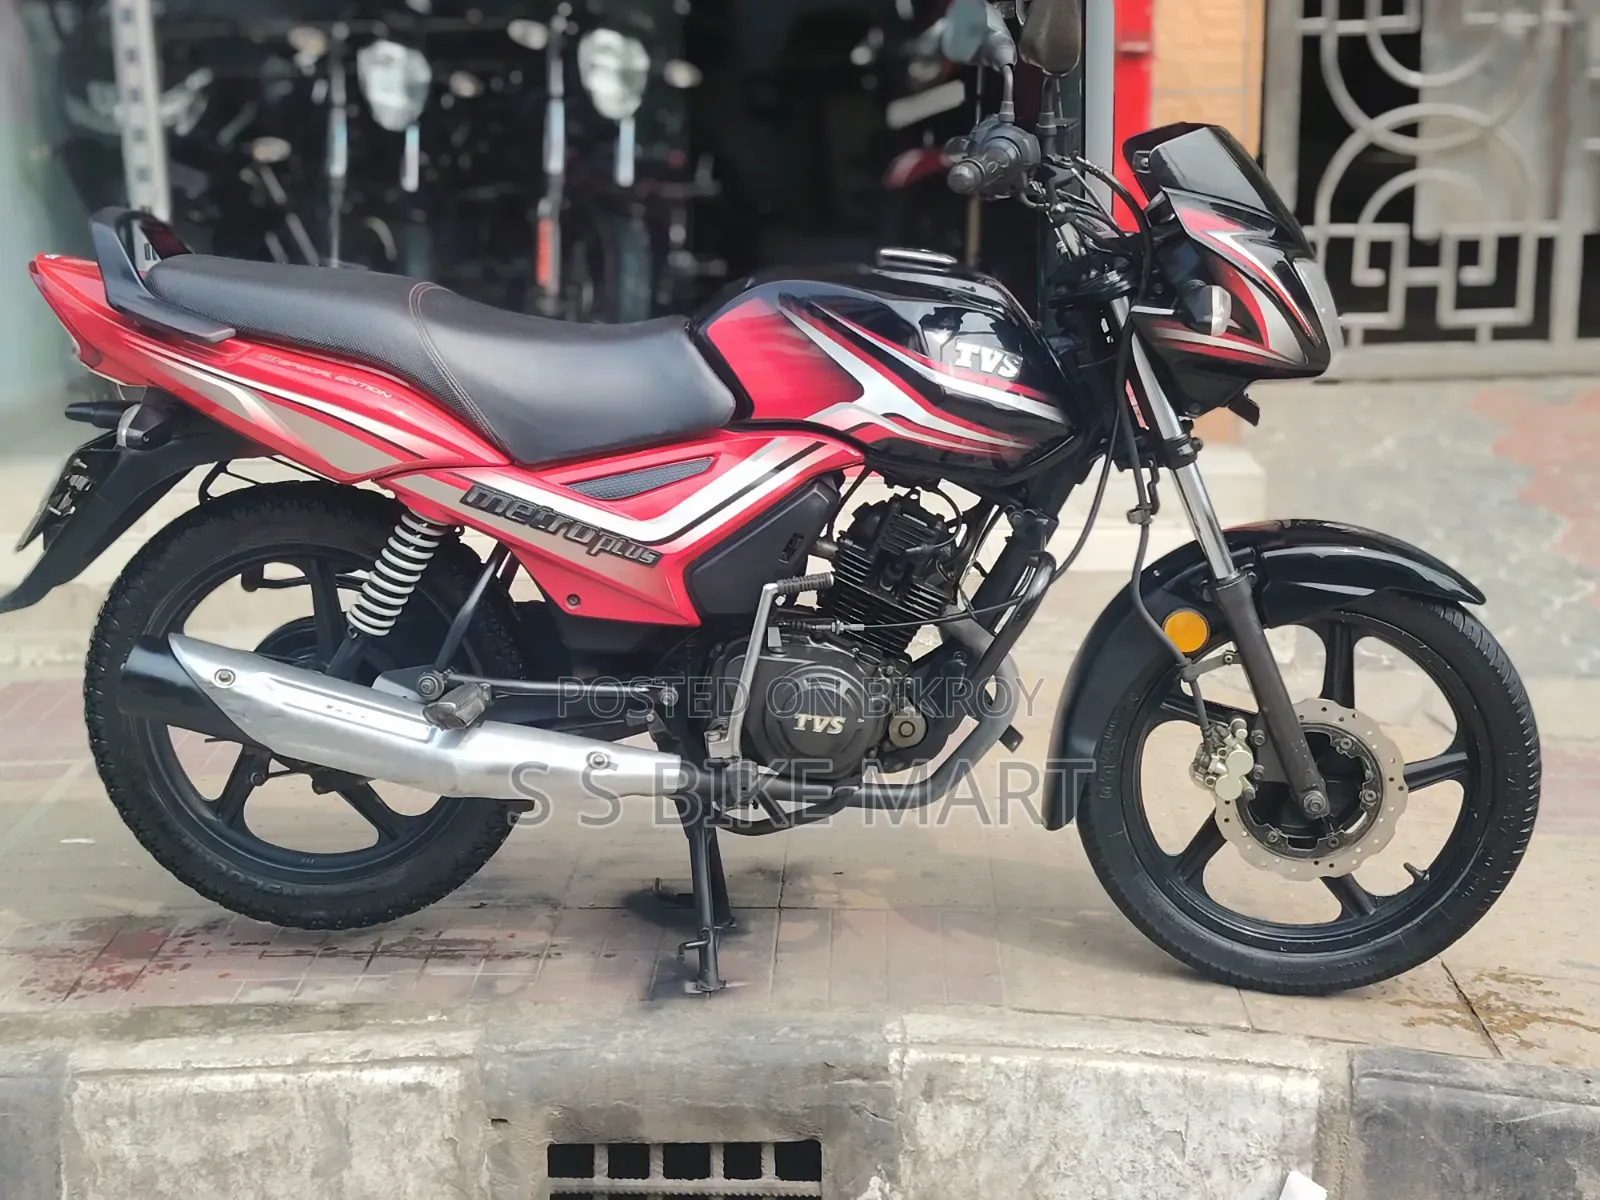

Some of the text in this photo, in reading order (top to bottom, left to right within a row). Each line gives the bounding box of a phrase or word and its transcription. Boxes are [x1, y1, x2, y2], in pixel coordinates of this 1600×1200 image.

[954, 341, 1023, 378] TVS
[334, 375, 393, 399] EDITION
[793, 713, 847, 735] TVS
